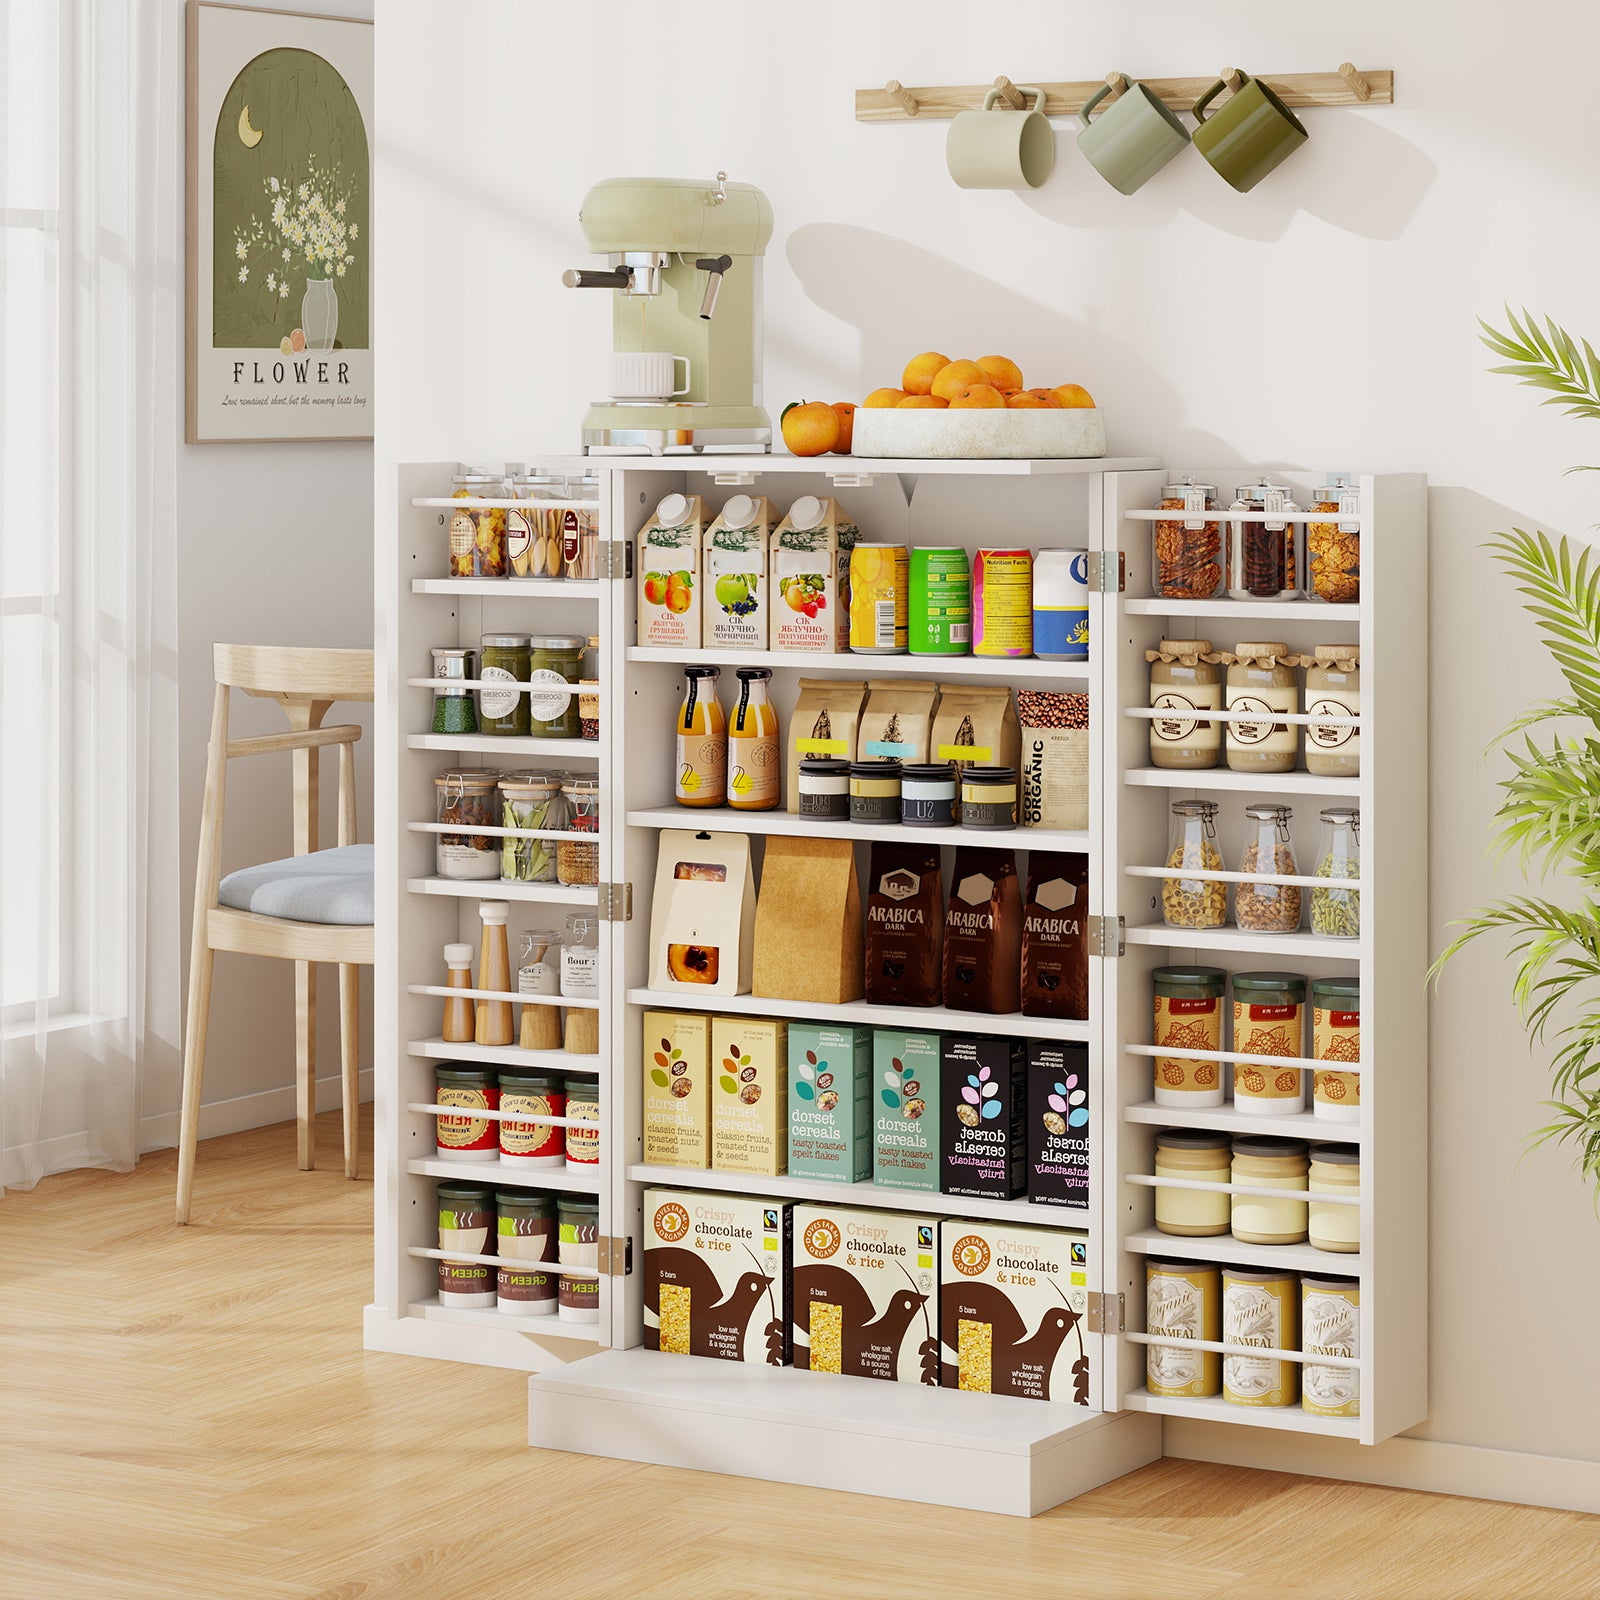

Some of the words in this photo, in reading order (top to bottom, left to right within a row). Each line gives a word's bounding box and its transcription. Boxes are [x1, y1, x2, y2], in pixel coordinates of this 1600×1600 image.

[233, 358, 350, 384] FLOWER
[986, 558, 1012, 566] Nutrition
[1013, 559, 1028, 567] Facts
[1031, 740, 1044, 823] ORGANIC
[868, 906, 924, 924] ARABICA
[945, 910, 993, 930] ARABICA
[885, 923, 905, 931] DARK
[959, 927, 977, 936] DARK
[1023, 916, 1079, 935] ARABICA
[1040, 934, 1061, 942] DARK
[567, 956, 590, 966] flour
[647, 1096, 689, 1113] dorset
[716, 1103, 758, 1119] dorset
[647, 1110, 694, 1126] cereals
[791, 1109, 835, 1125] dorset
[647, 1125, 676, 1135] classic
[677, 1127, 703, 1138] fruits,
[716, 1117, 764, 1133] cereals
[791, 1124, 841, 1140] cereals
[877, 1117, 921, 1134] dorset
[647, 1135, 679, 1145] roasted
[680, 1138, 700, 1147] nuts
[716, 1131, 745, 1142] classic
[746, 1134, 772, 1145] fruits,
[792, 1138, 814, 1149] tasty
[815, 1140, 847, 1151] toasted
[877, 1132, 927, 1148] cereals
[647, 1144, 655, 1152] &
[656, 1144, 680, 1154] seeds
[716, 1142, 748, 1152] roasted
[749, 1145, 769, 1154] nuts
[792, 1149, 813, 1160] spelt
[814, 1149, 840, 1161] flakes
[878, 1147, 900, 1157] tasty
[901, 1148, 934, 1160] toasted
[716, 1151, 724, 1159] &
[725, 1152, 749, 1162] seeds
[878, 1157, 899, 1168] spelt
[901, 1158, 926, 1169] flakes
[655, 1205, 671, 1227] DOVES
[671, 1204, 688, 1223] FARM
[695, 1206, 735, 1224] Crispy
[659, 1225, 687, 1241] ORGANIC
[695, 1222, 752, 1239] chocolate
[805, 1220, 821, 1243] DOVES
[822, 1220, 838, 1239] FARM
[846, 1222, 889, 1241] Crispy
[695, 1237, 705, 1249] &
[708, 1239, 731, 1252] rice
[809, 1241, 838, 1258] ORGANIC
[846, 1238, 906, 1256] chocolate
[953, 1237, 970, 1260] DOVES
[970, 1236, 989, 1256] FARM
[996, 1238, 1040, 1258] Crispy
[846, 1254, 857, 1265] &
[860, 1256, 885, 1269] rice
[958, 1258, 989, 1275] ORGANIC
[996, 1255, 1059, 1274] chocolate
[665, 1271, 677, 1279] bars
[996, 1271, 1007, 1283] &
[1011, 1273, 1036, 1287] rice
[815, 1289, 827, 1297] bars
[964, 1307, 977, 1315] bars
[718, 1325, 728, 1333] low
[1148, 1324, 1196, 1339] CORNMEAL
[708, 1332, 737, 1343] wholegrain
[1226, 1334, 1273, 1348] CORNMEAL
[719, 1342, 737, 1350] source
[870, 1344, 880, 1352] low
[1304, 1343, 1354, 1358] CORNMEAL
[726, 1349, 738, 1358] fibre
[860, 1351, 890, 1362] wholegrain
[871, 1361, 890, 1369] source
[1022, 1362, 1032, 1371] low
[872, 1368, 879, 1376] of
[879, 1369, 891, 1378] fibre
[1011, 1370, 1042, 1381] wholegrain
[1030, 1388, 1043, 1397] fibre
